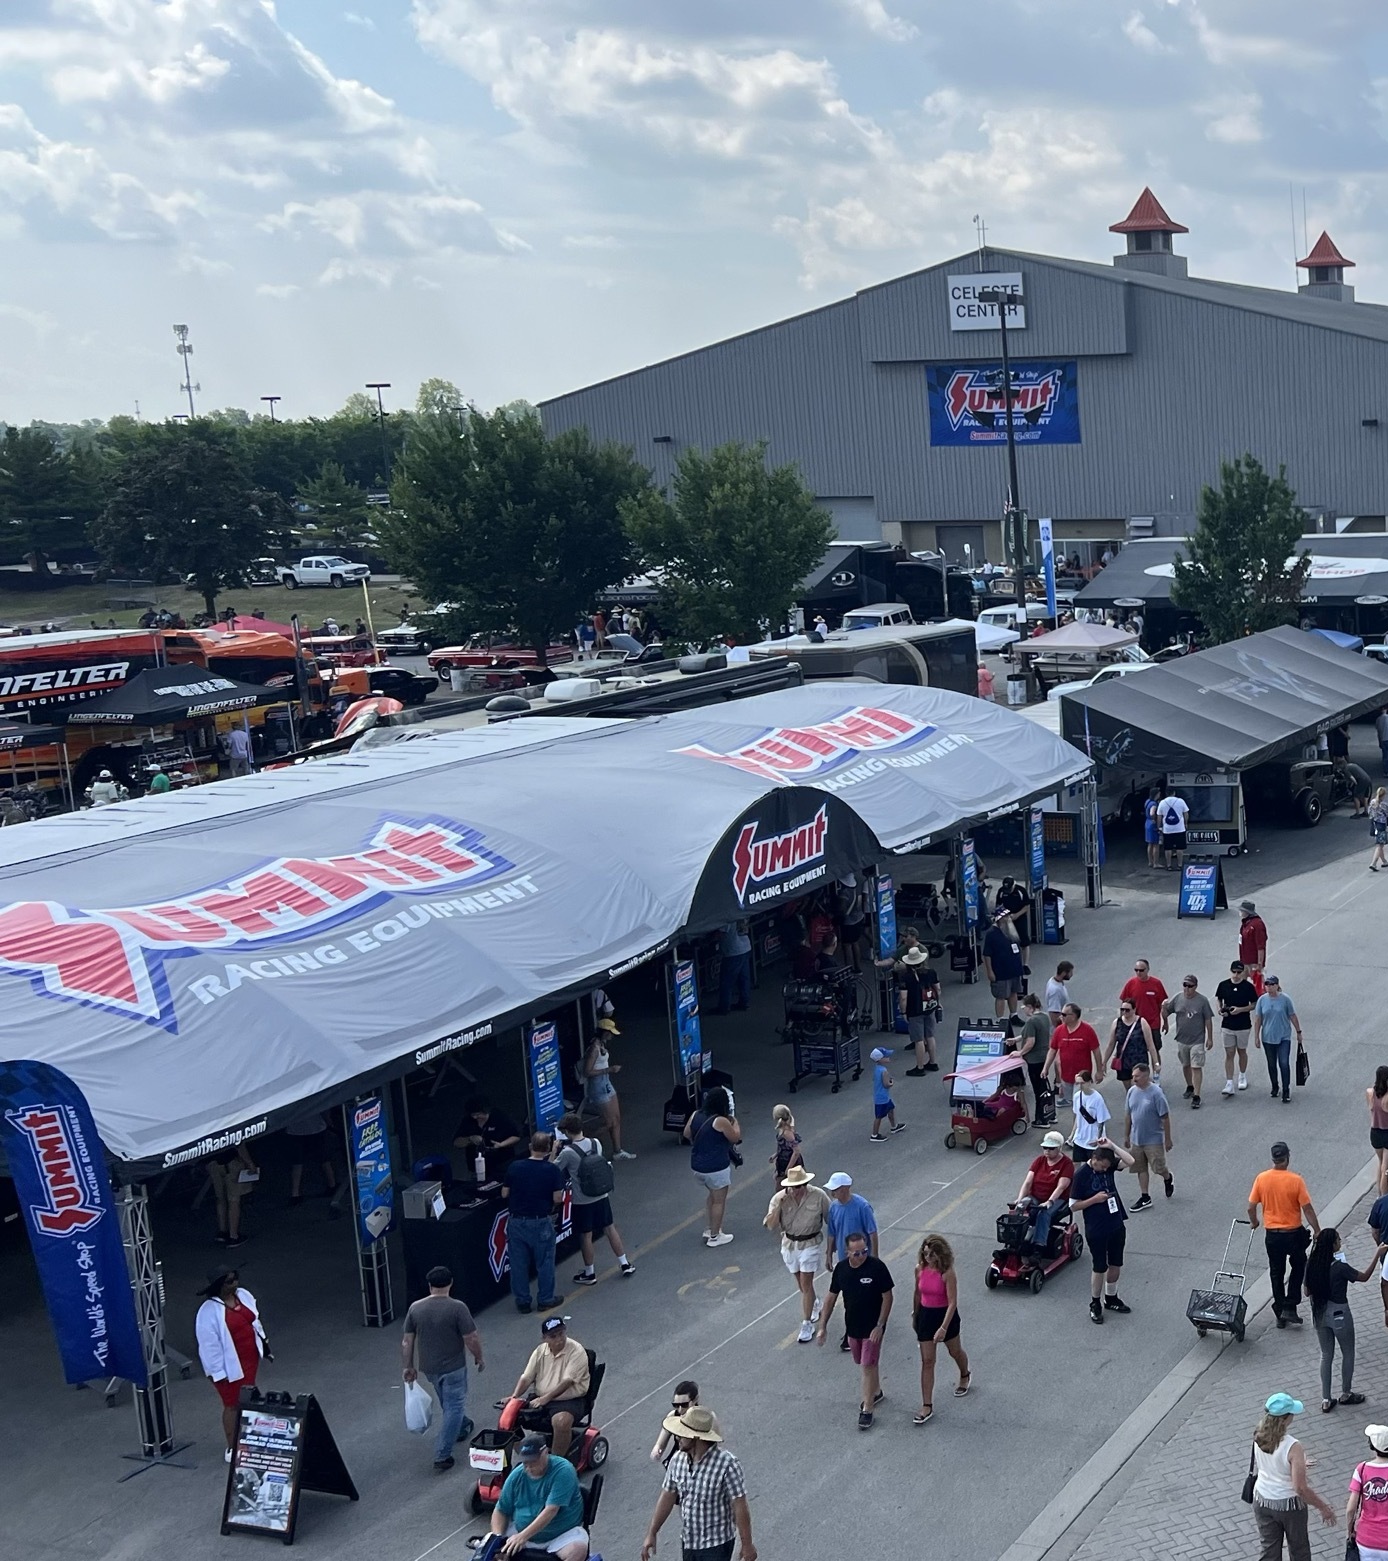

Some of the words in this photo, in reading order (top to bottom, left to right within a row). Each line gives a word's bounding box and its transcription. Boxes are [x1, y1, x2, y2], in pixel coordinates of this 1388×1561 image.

[749, 884, 781, 905] RACING
[783, 863, 827, 892] EQUIPMENT
[188, 939, 350, 1005] RACING
[356, 875, 539, 955] EQUIPMENT
[415, 1021, 493, 1066] SummitRacing.com
[65, 1105, 91, 1164] EQUIPMENT
[162, 1117, 268, 1169] SummitRacing.com
[84, 1163, 102, 1205] RACING
[76, 1240, 97, 1271] Shop
[84, 1270, 104, 1303] Speed
[87, 1302, 109, 1339] World's
[92, 1338, 110, 1368] The
